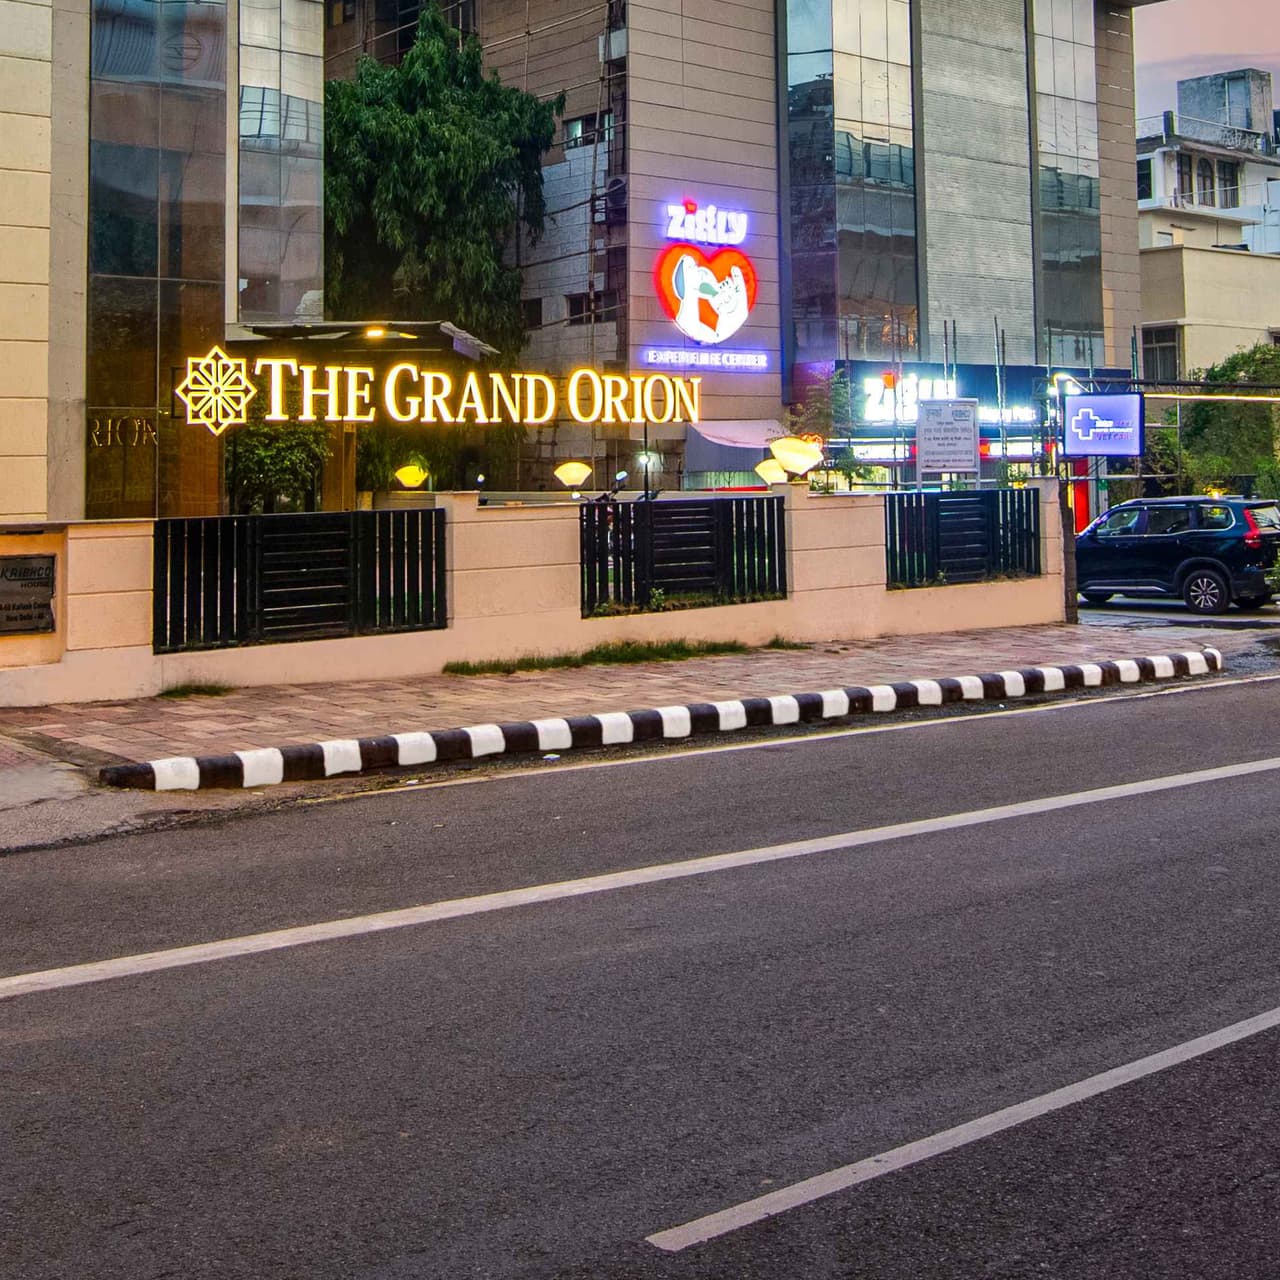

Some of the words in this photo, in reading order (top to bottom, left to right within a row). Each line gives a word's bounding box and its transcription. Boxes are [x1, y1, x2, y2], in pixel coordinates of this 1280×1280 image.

[253, 358, 376, 422] THE
[383, 363, 556, 424] GRAND
[567, 368, 703, 424] ORION
